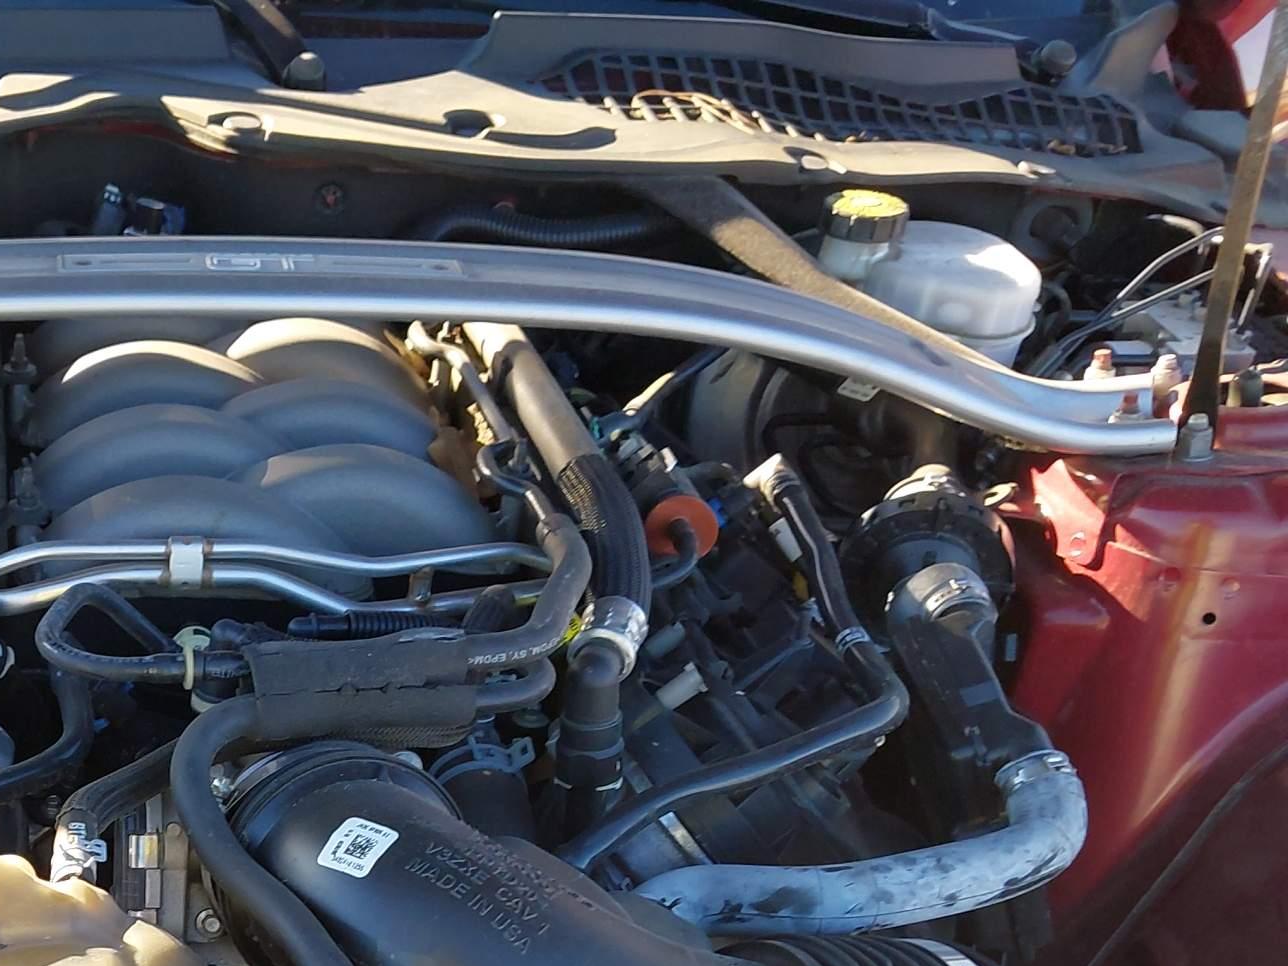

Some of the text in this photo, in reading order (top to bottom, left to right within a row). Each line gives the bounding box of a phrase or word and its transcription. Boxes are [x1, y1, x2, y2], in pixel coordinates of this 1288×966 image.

[405, 859, 471, 899] MADE
[467, 894, 494, 917] IN
[490, 912, 531, 955] USA
